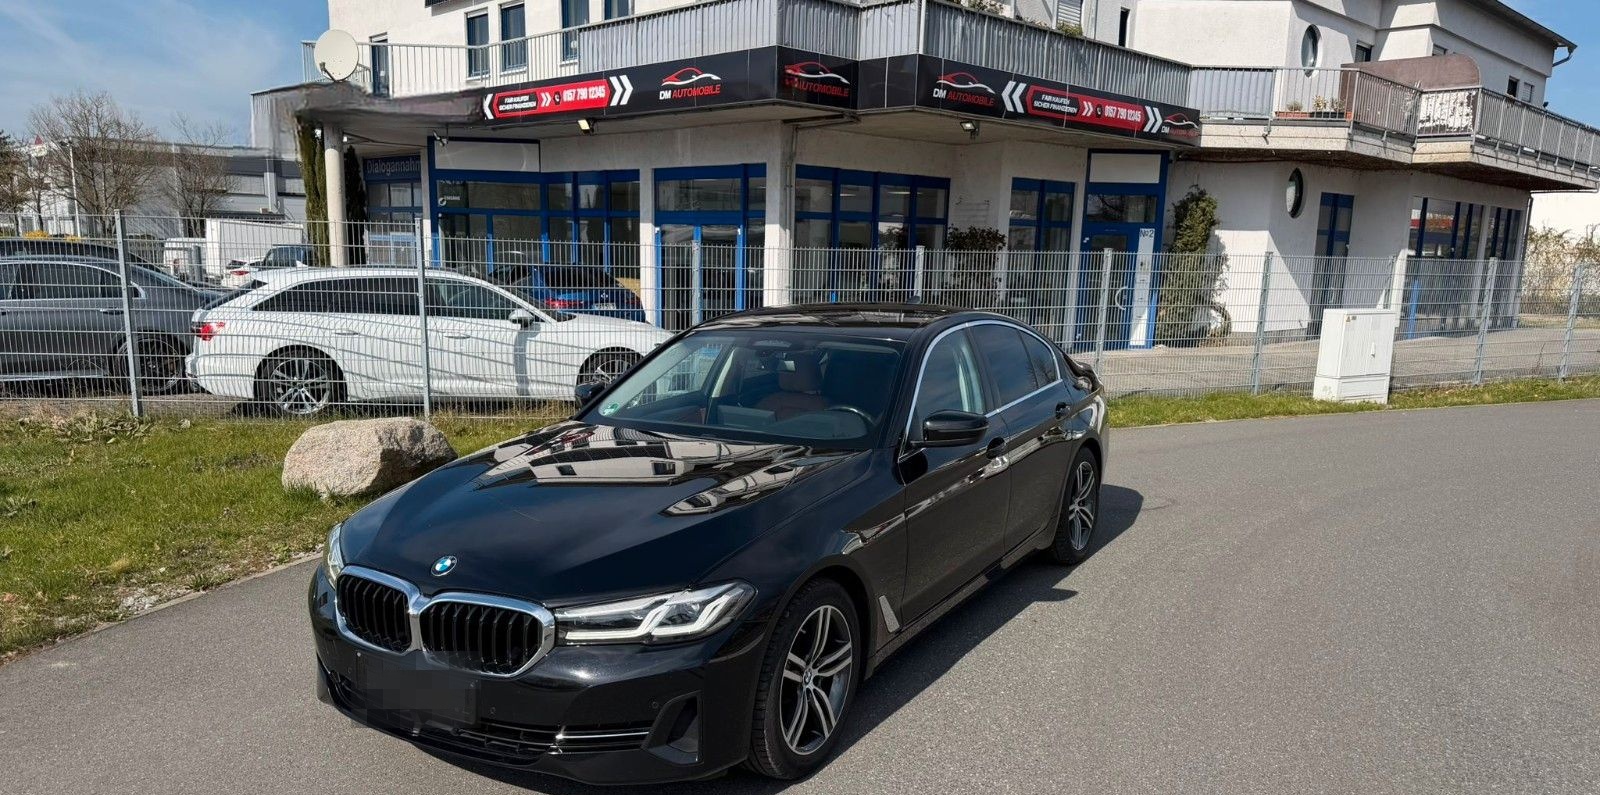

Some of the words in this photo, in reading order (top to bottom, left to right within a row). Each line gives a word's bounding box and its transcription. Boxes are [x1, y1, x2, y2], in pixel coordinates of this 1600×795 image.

[659, 90, 671, 100] DM
[672, 84, 721, 98] AUTOMOBILE
[798, 79, 849, 97] AUTOMOBILE
[933, 88, 947, 99] DM
[947, 91, 995, 107] AUTOMOBILE
